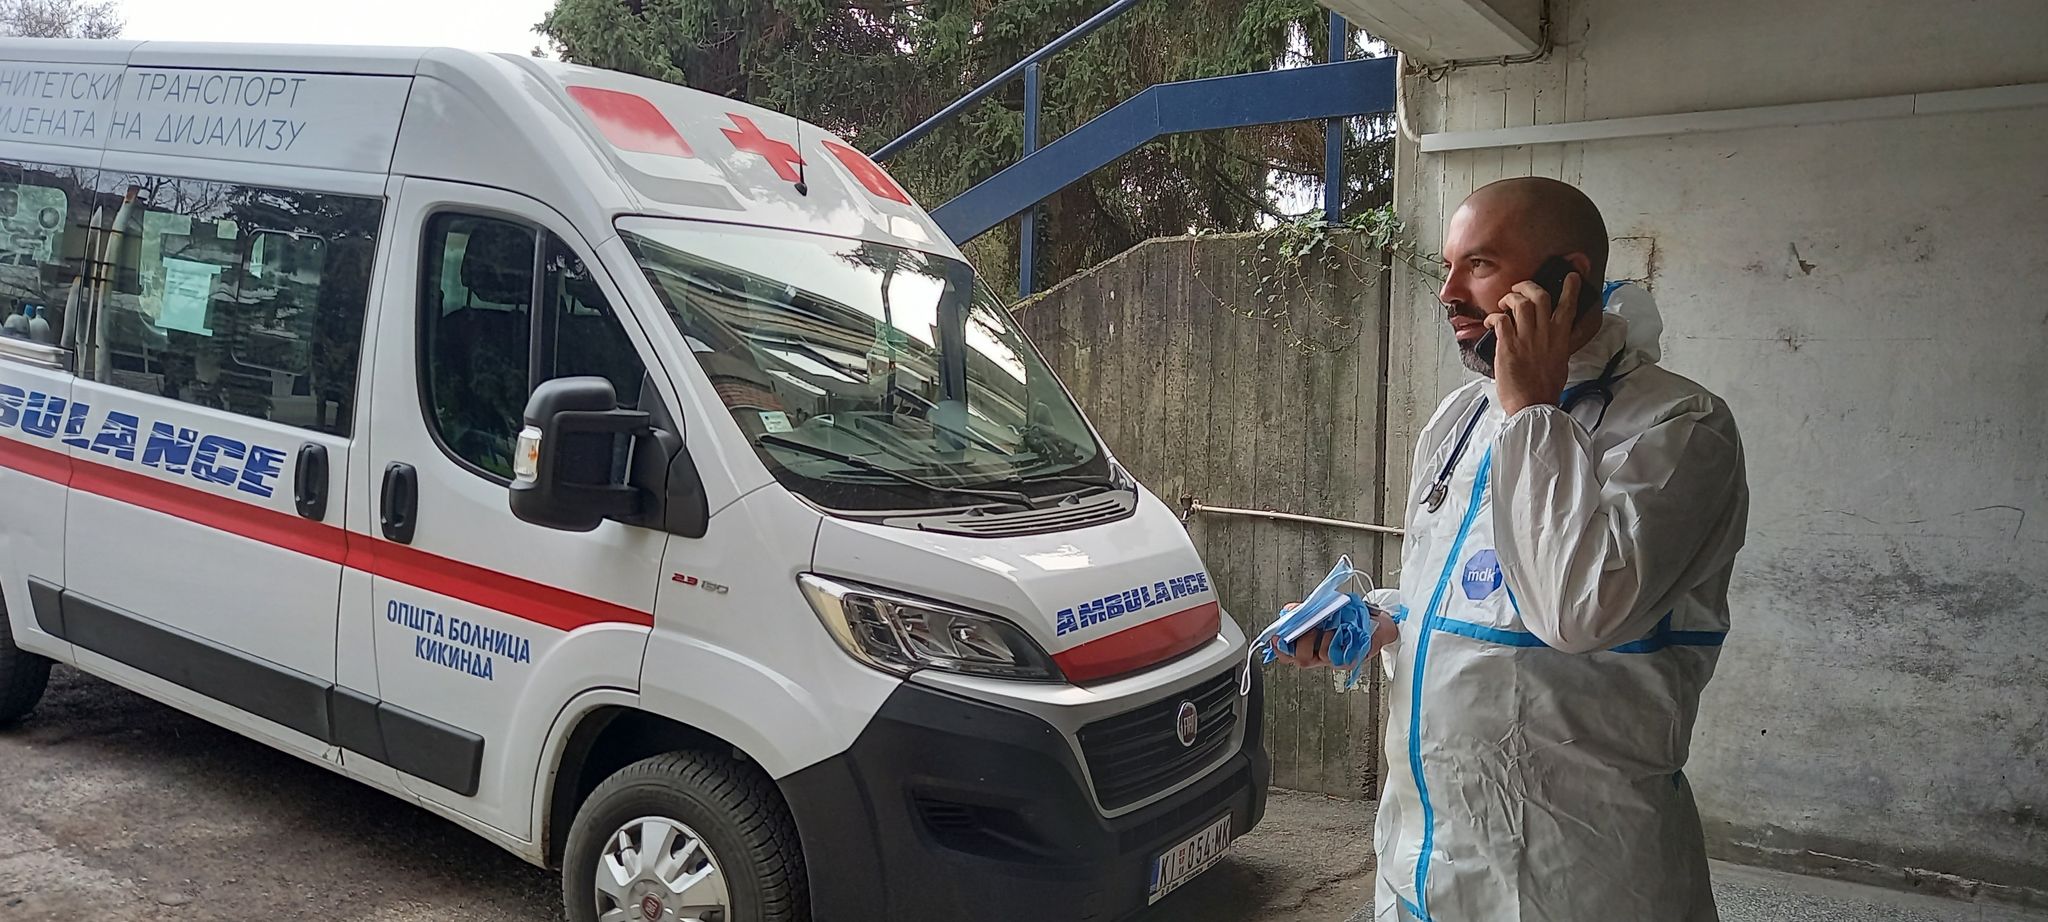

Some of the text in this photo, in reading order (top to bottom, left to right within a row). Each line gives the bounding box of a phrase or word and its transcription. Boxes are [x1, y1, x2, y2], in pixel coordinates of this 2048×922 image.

[136, 73, 306, 108] ТРАНСПОРТ
[109, 111, 142, 140] НА
[155, 113, 306, 151] ДИЈАЛИЗУ
[1467, 567, 1496, 582] mdk
[1056, 571, 1209, 637] AMBULANCE
[387, 599, 531, 664] ОПШТА БОЛНИЦА
[415, 635, 494, 681] КИКИНДА
